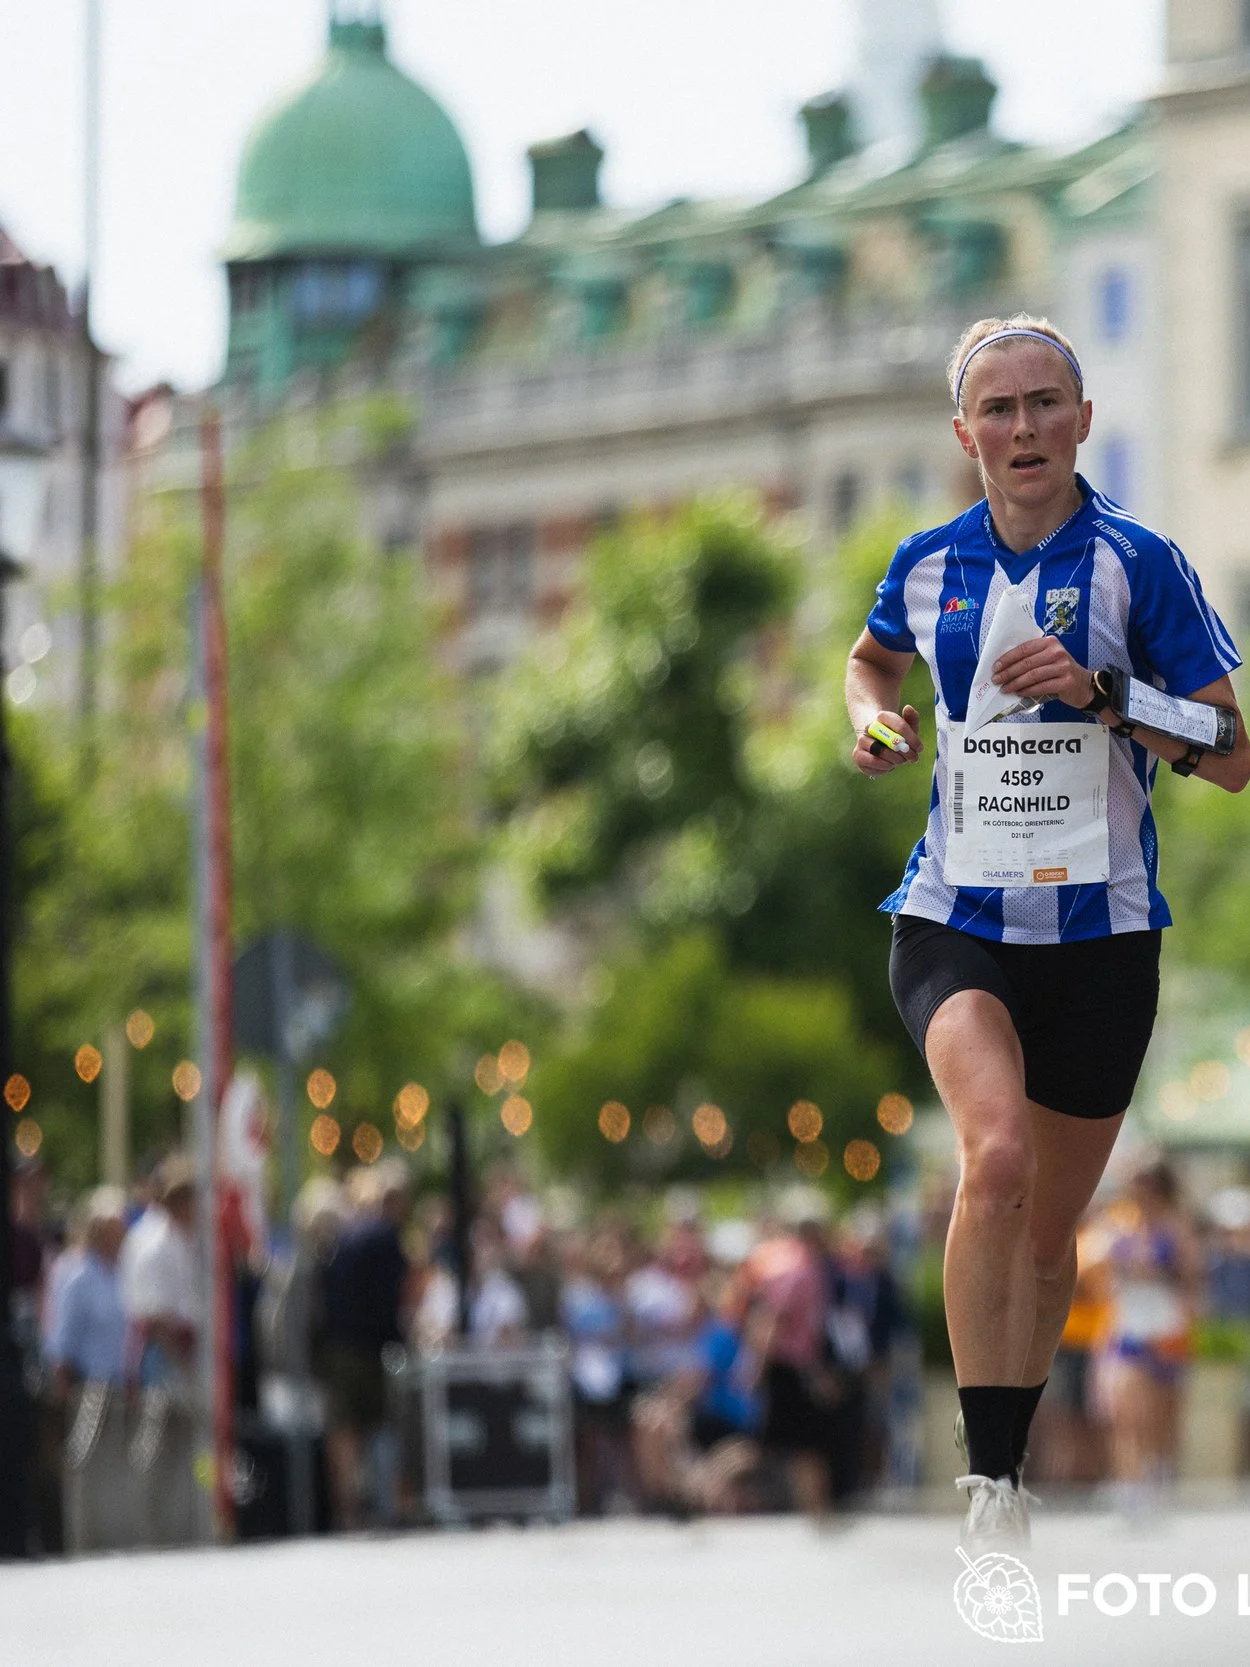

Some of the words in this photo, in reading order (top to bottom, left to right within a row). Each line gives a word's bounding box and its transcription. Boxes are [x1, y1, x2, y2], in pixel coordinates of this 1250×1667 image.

[1000, 769, 1044, 787] 4589
[978, 795, 1071, 812] RAGNHILD
[992, 819, 1024, 828] GÖTEBORG
[1024, 819, 1065, 828] ORIENTERING
[982, 870, 1025, 879] CHALMERS
